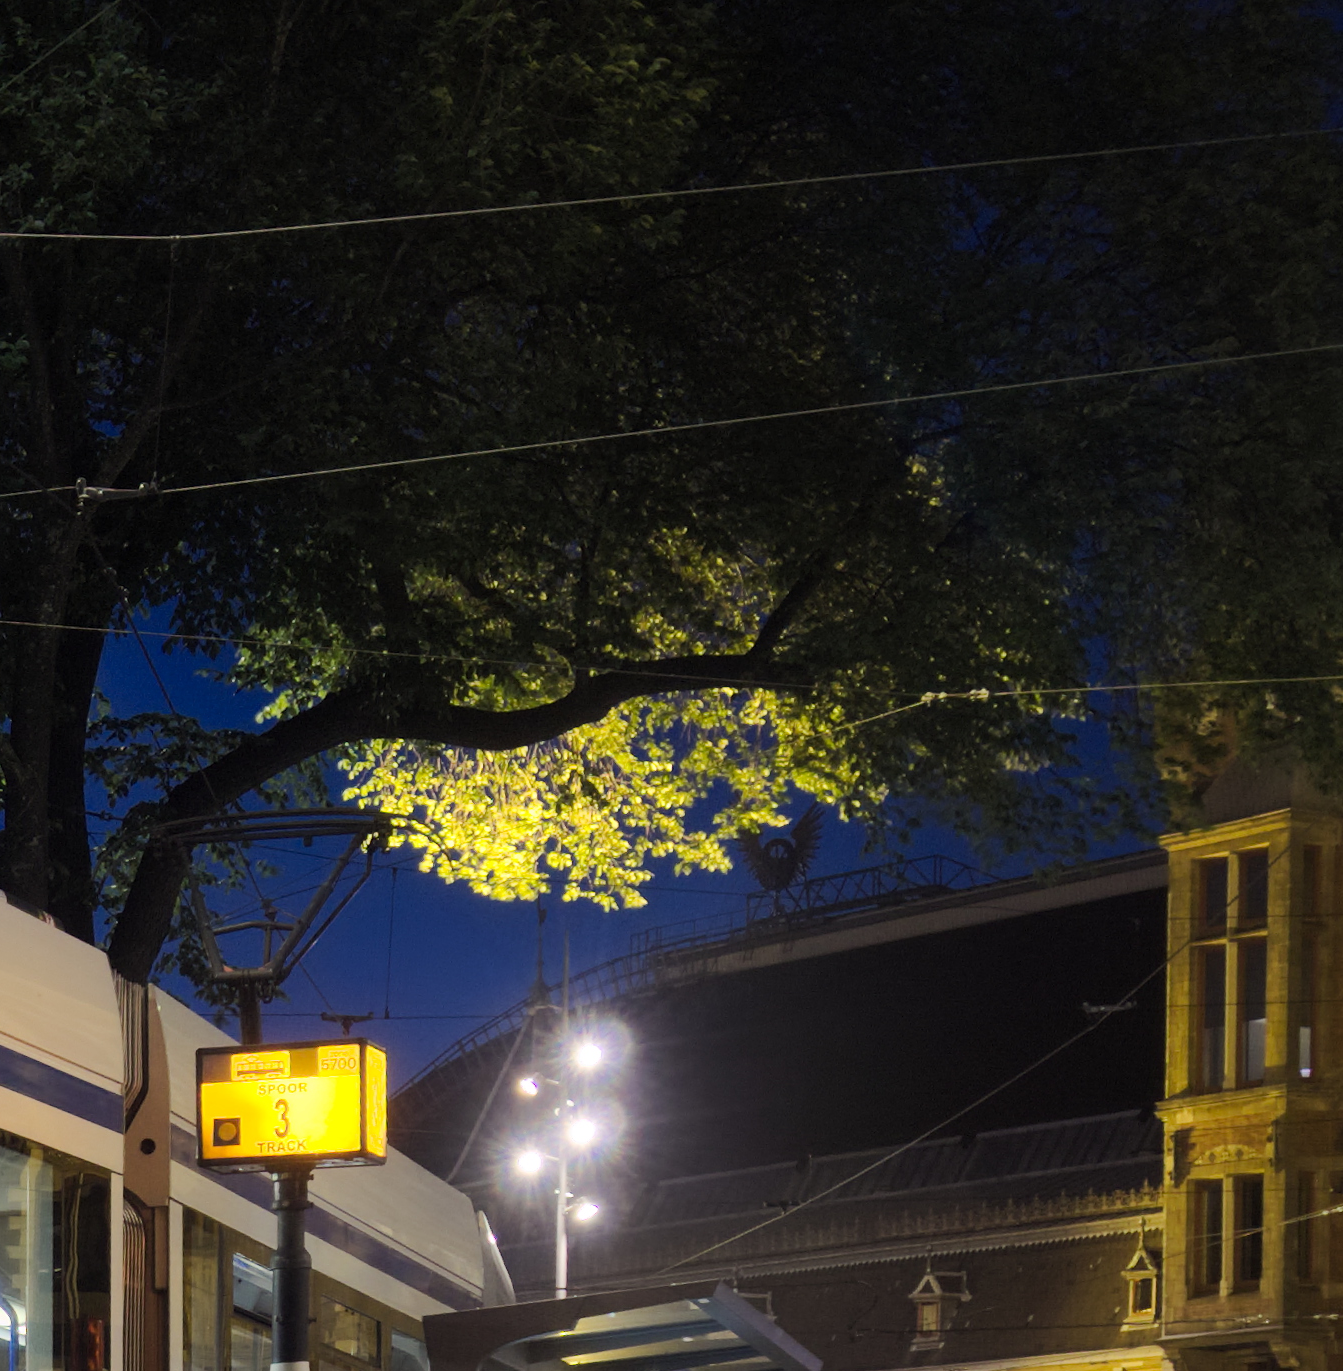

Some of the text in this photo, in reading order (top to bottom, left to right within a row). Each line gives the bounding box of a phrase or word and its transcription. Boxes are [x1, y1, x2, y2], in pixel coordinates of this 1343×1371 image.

[321, 1057, 356, 1070] 5700
[258, 1083, 307, 1096] SPOOR
[274, 1099, 289, 1138] 3
[257, 1140, 306, 1153] TRACK
